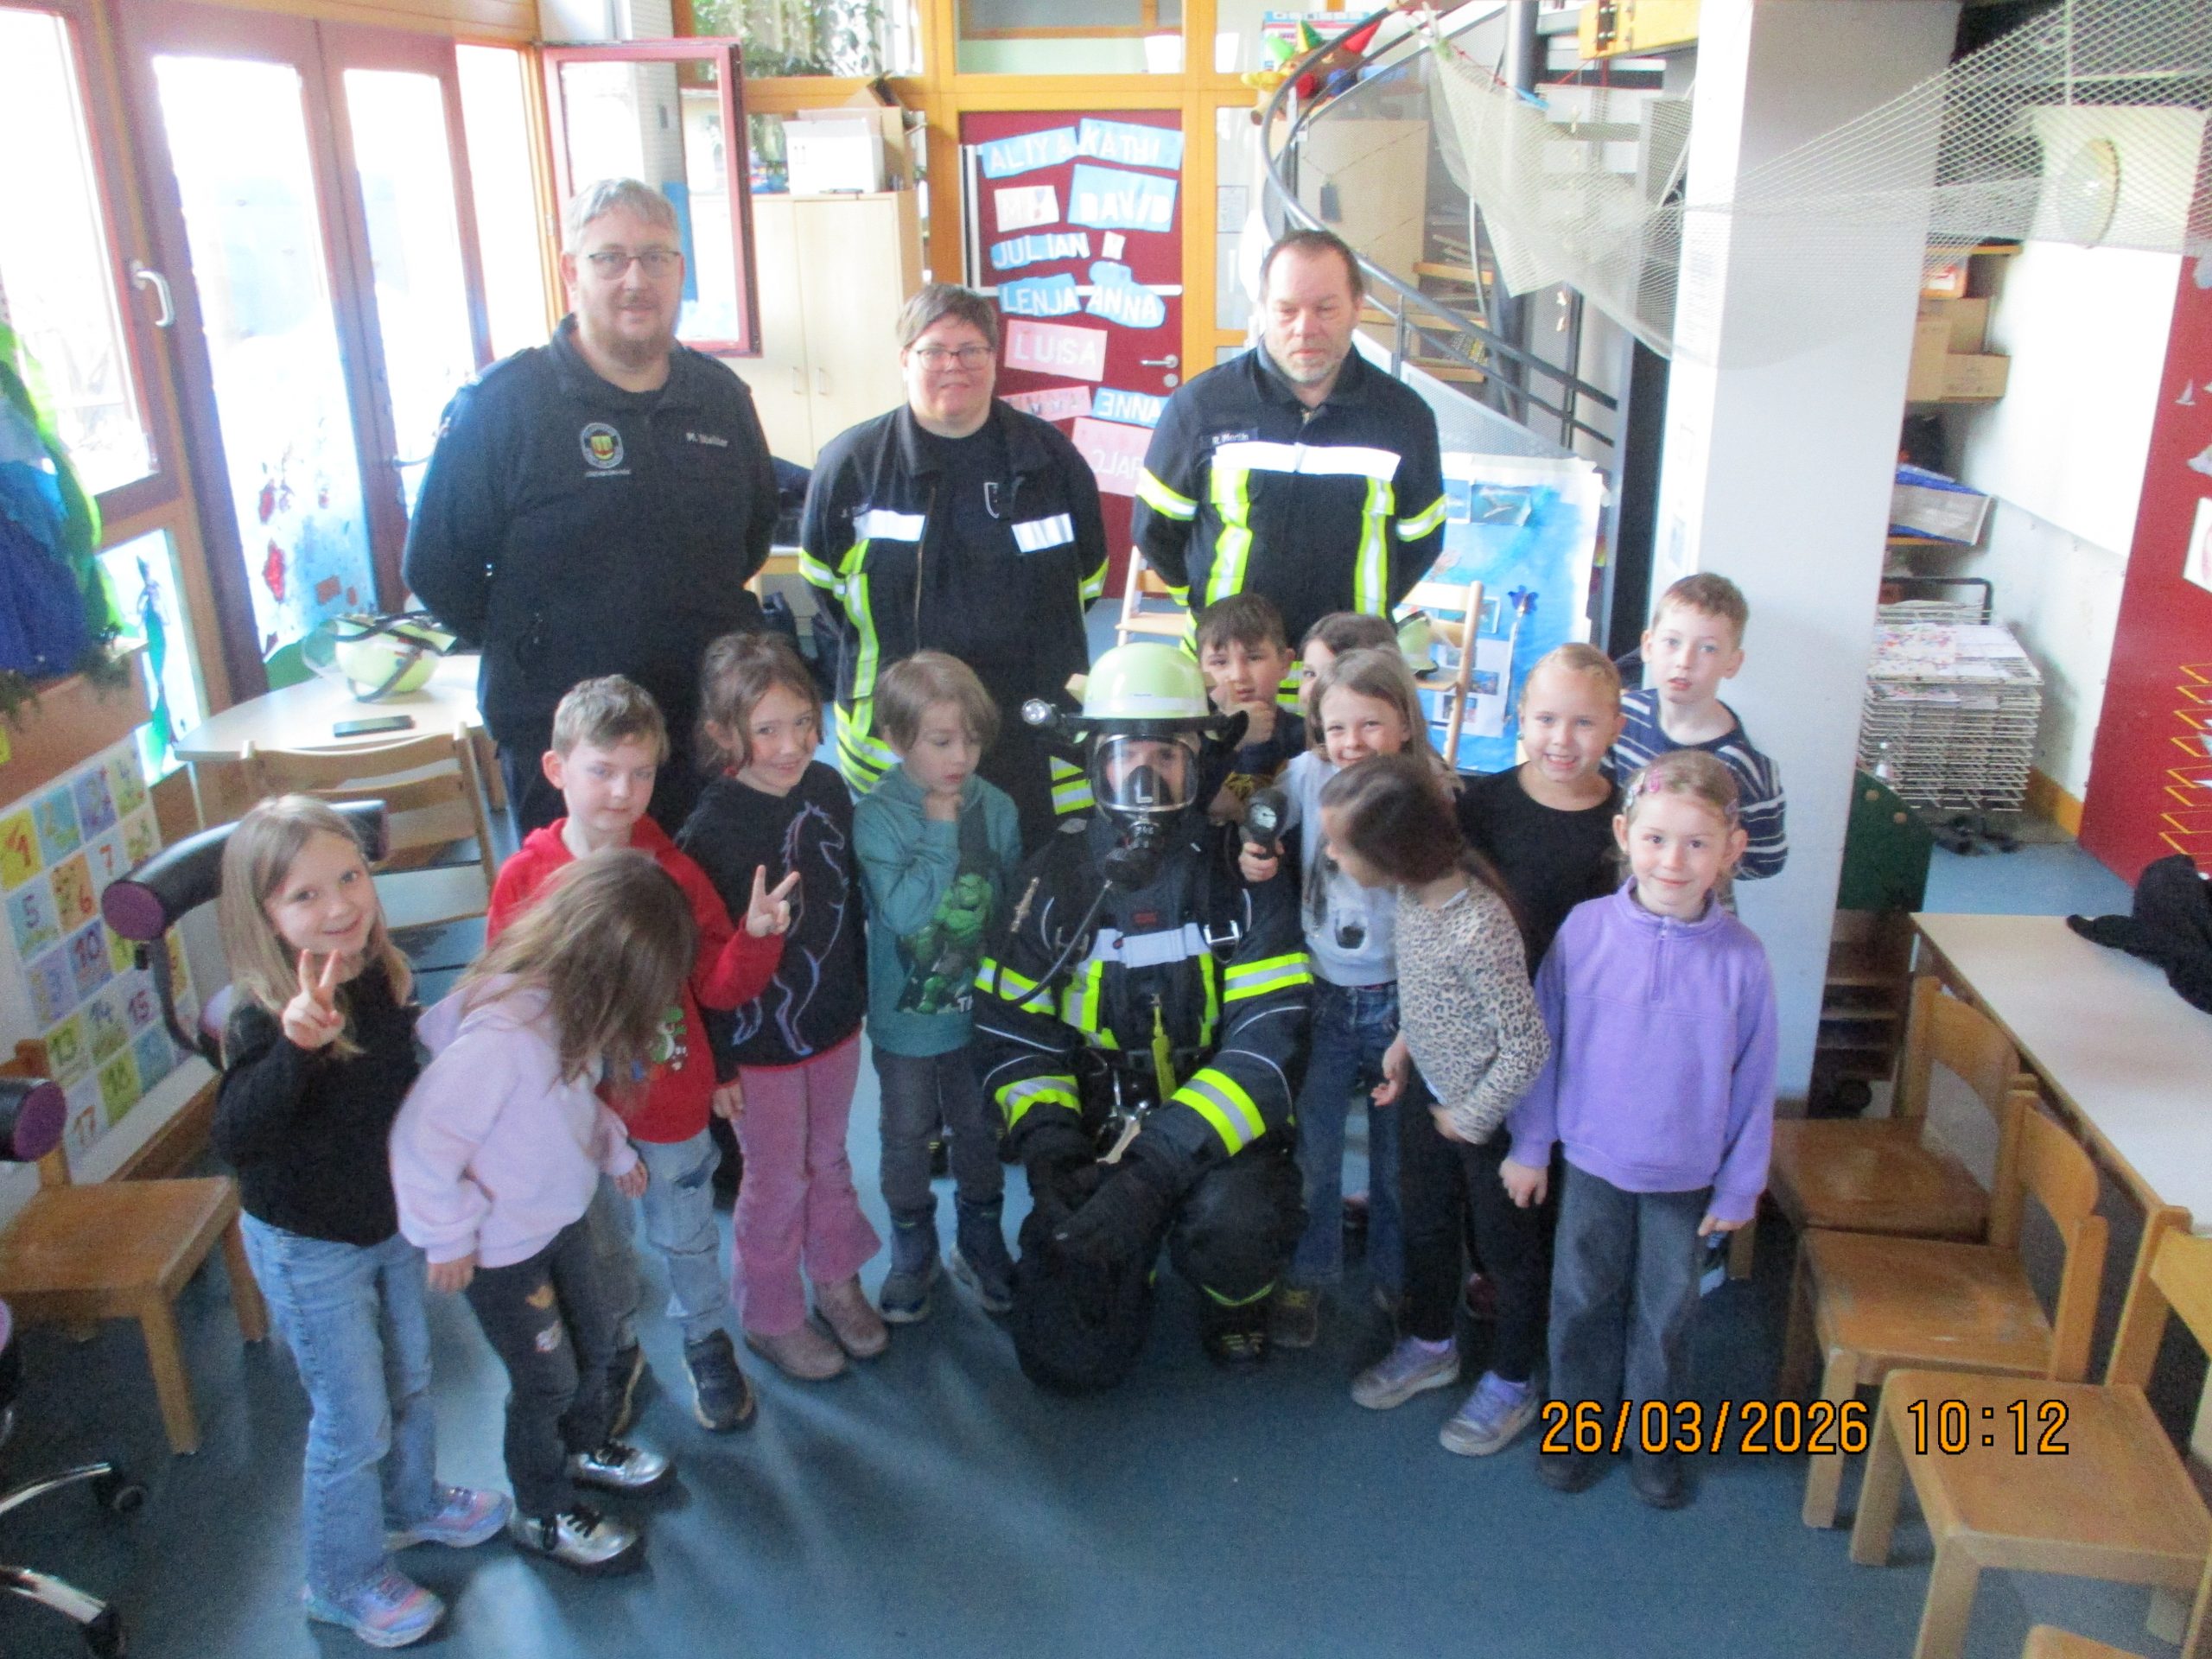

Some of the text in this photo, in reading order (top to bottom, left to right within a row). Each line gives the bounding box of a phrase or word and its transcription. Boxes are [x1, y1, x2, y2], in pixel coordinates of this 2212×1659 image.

[990, 133, 1077, 171] ALIYA
[1078, 126, 1160, 165] KATHI
[1079, 190, 1171, 223] DAVID
[995, 233, 1090, 267] JULIAN
[1002, 287, 1080, 314] LENJA
[1089, 286, 1159, 322] ANNA
[1014, 334, 1097, 365] LUISA
[22, 843, 113, 929] 5 6 7
[73, 929, 101, 969] 10
